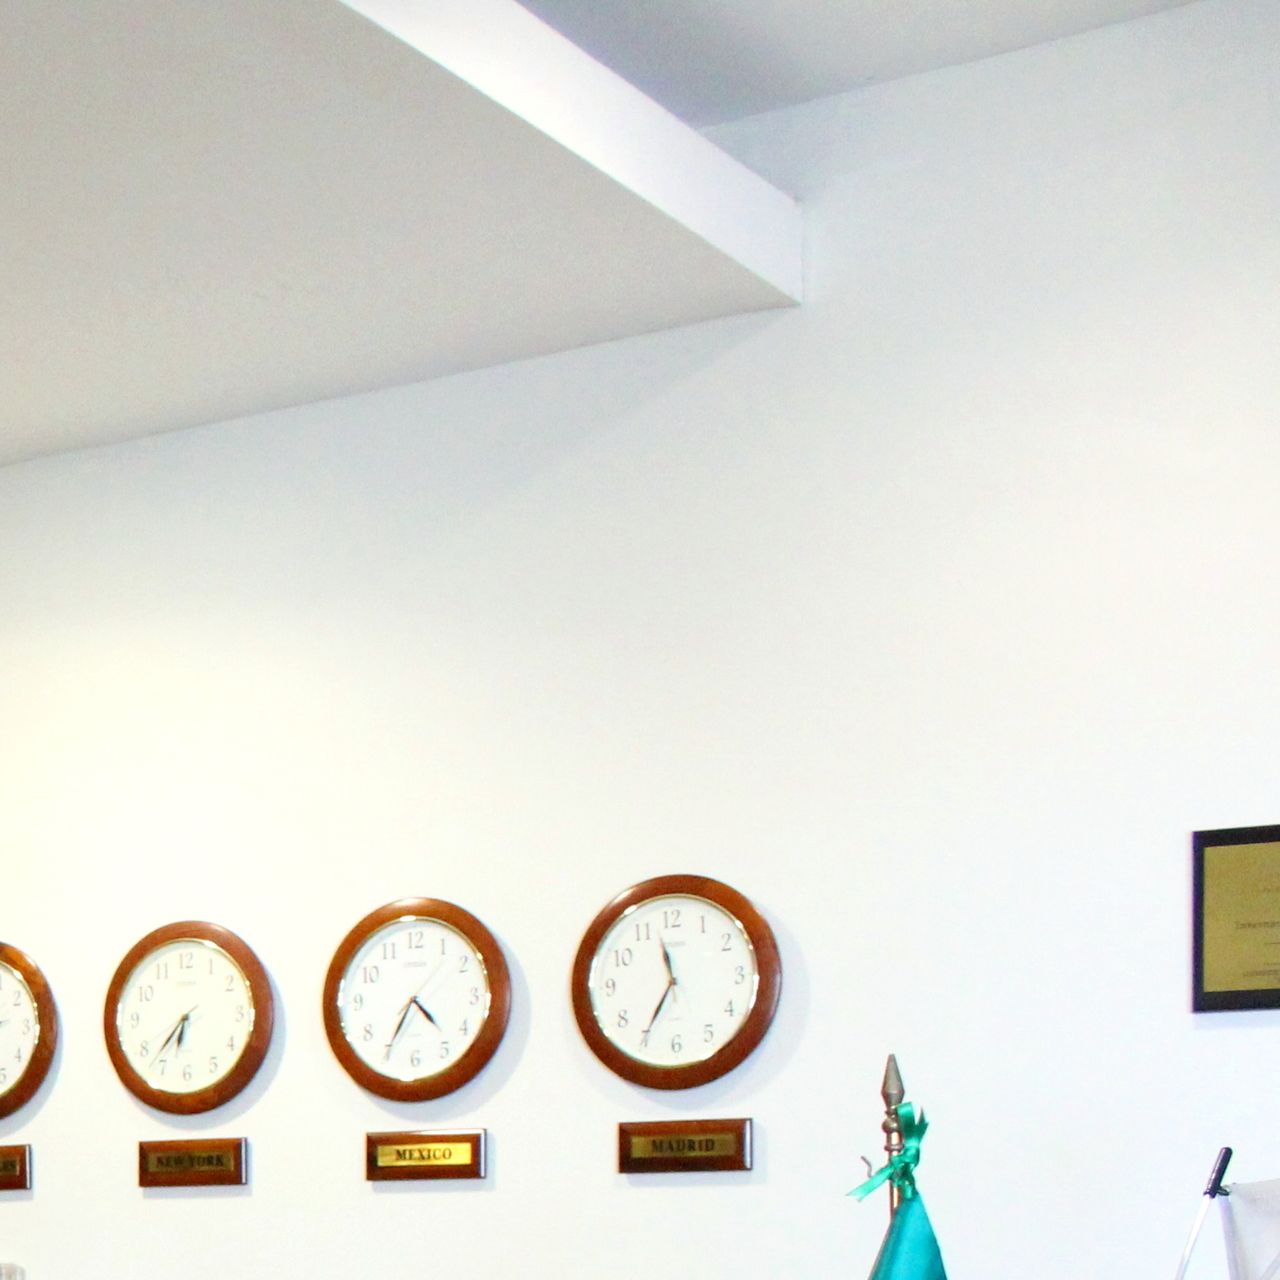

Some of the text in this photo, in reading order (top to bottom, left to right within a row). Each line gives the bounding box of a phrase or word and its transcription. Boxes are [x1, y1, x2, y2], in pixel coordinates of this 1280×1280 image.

[663, 909, 681, 929] 12
[408, 931, 424, 949] 12
[635, 922, 650, 941] 11
[722, 933, 732, 952] 2
[382, 943, 396, 960] 11
[614, 948, 632, 967] 10
[179, 952, 193, 969] 12
[459, 956, 468, 973] 2
[156, 962, 169, 979] 11
[362, 965, 379, 984] 10
[735, 965, 745, 985] 3
[226, 975, 234, 992] 2
[605, 978, 616, 997] 9
[13, 991, 21, 1006] 2
[139, 985, 154, 1002] 10
[469, 987, 479, 1005] 3
[354, 994, 363, 1011] 9
[724, 1000, 734, 1017] 4
[131, 1012, 139, 1029] 9
[235, 1006, 244, 1023] 3
[618, 1009, 628, 1028] 8
[22, 1019, 30, 1035] 3
[363, 1024, 373, 1041] 8
[459, 1019, 468, 1036] 4
[704, 1024, 714, 1043] 5
[140, 1040, 149, 1057] 8
[227, 1036, 234, 1051] 4
[440, 1041, 449, 1059] 5
[671, 1034, 682, 1053] 6
[15, 1047, 21, 1062] 4
[410, 1050, 420, 1067] 6
[159, 1059, 167, 1075] 7
[183, 1065, 192, 1081] 6
[209, 1057, 218, 1073] 5
[0, 1067, 7, 1084] 5
[395, 1147, 453, 1161] MEXICO
[651, 1138, 715, 1153] MADRID
[156, 1154, 224, 1168] NEW YORK
